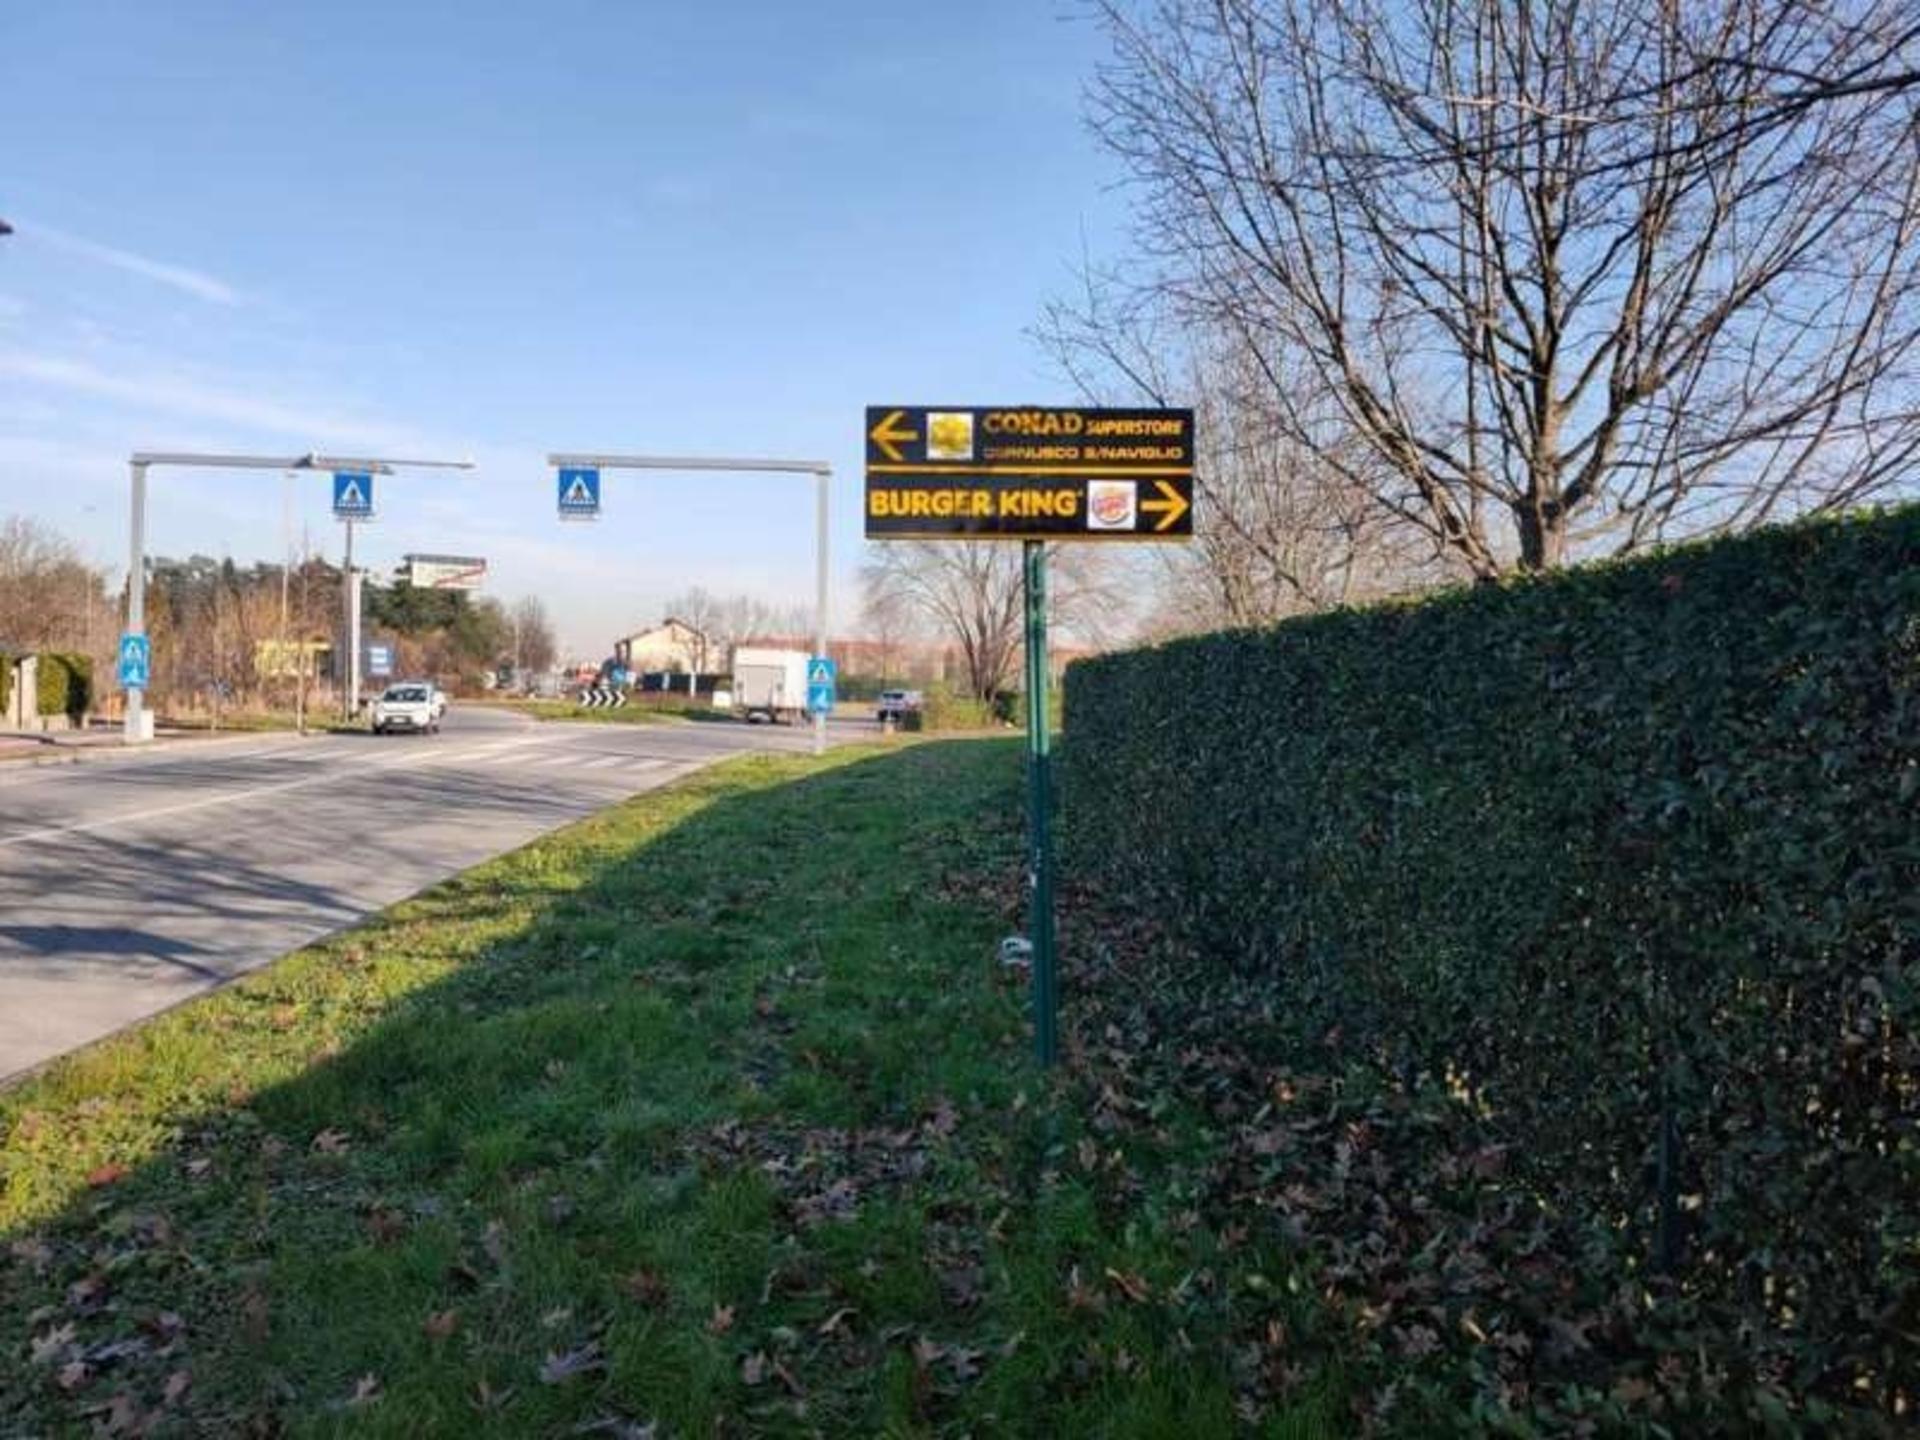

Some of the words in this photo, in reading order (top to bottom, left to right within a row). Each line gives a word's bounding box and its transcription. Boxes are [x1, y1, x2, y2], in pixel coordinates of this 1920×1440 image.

[983, 412, 1083, 434] CONAD
[1085, 419, 1184, 435] SUPERSTORE
[869, 489, 991, 516] BURGER
[1000, 489, 1077, 516] KING
